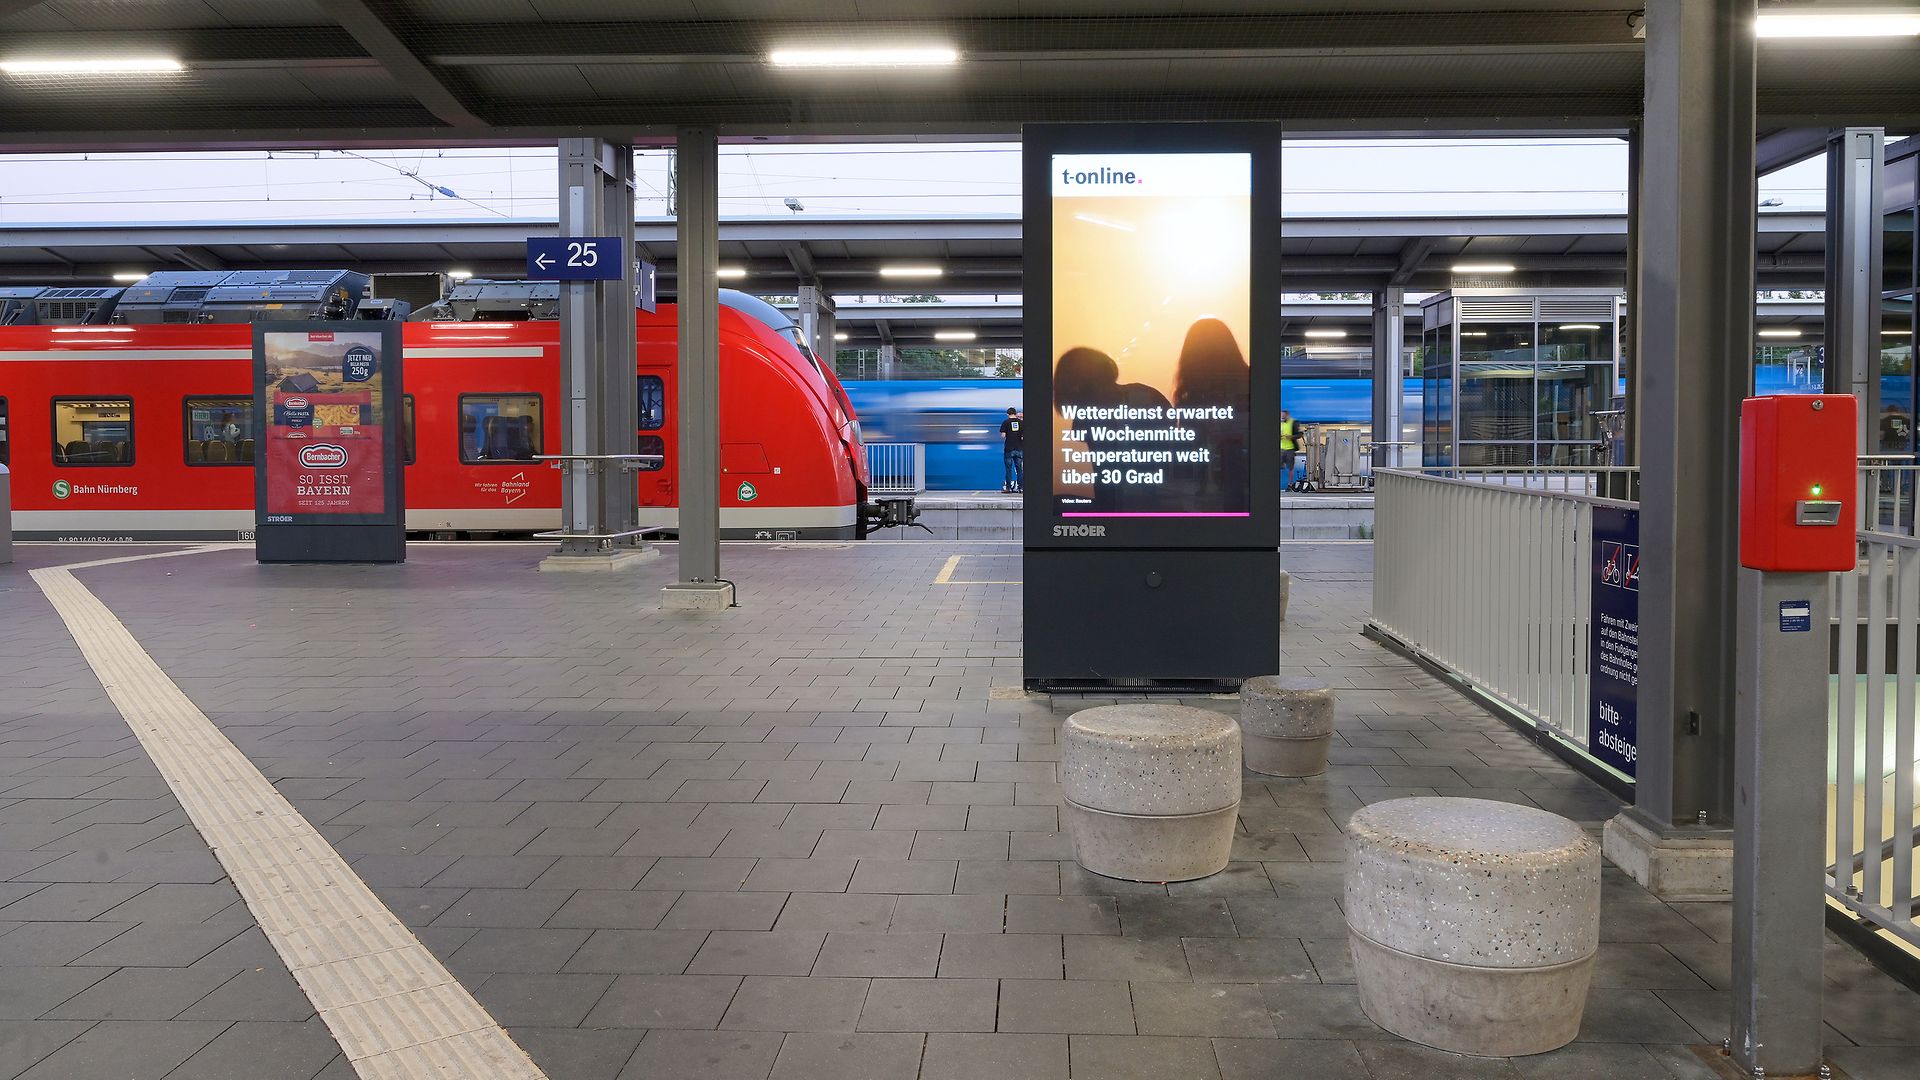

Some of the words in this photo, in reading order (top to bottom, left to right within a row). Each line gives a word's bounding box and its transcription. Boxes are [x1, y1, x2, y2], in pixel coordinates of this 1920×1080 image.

[1062, 167, 1143, 185] t-online.
[567, 242, 598, 267] 25
[649, 269, 655, 302] 1
[347, 354, 362, 363] JETZT
[1061, 404, 1163, 420] Wetterdienst
[1166, 404, 1234, 420] erwartet
[1061, 428, 1088, 441] zur
[1091, 425, 1196, 442] Wochenmitte
[306, 452, 341, 461] Bernbacher
[1061, 447, 1172, 467] Temperaturen
[1176, 447, 1210, 463] weit
[299, 474, 314, 485] SO
[319, 474, 349, 485] ISST
[1061, 468, 1098, 484] über
[1101, 468, 1122, 484] 30
[1126, 468, 1164, 484] Grad
[73, 484, 96, 494] Bahn
[97, 484, 138, 496] Nürnberg
[296, 485, 351, 496] BAYERN
[500, 487, 521, 495] Bayern
[1052, 524, 1106, 537] STRÖER
[1600, 612, 1617, 626] Fahren
[1616, 618, 1625, 629] mit
[1600, 626, 1609, 636] auf
[1608, 628, 1618, 640] den
[1600, 637, 1606, 648] in
[1605, 640, 1615, 651] den
[1600, 650, 1609, 662] des
[1608, 653, 1633, 670] Bahnhofes
[1600, 664, 1619, 680] ordnung
[1618, 670, 1631, 683] nicht
[1599, 700, 1620, 726] bitte
[1598, 727, 1637, 763] absteige
